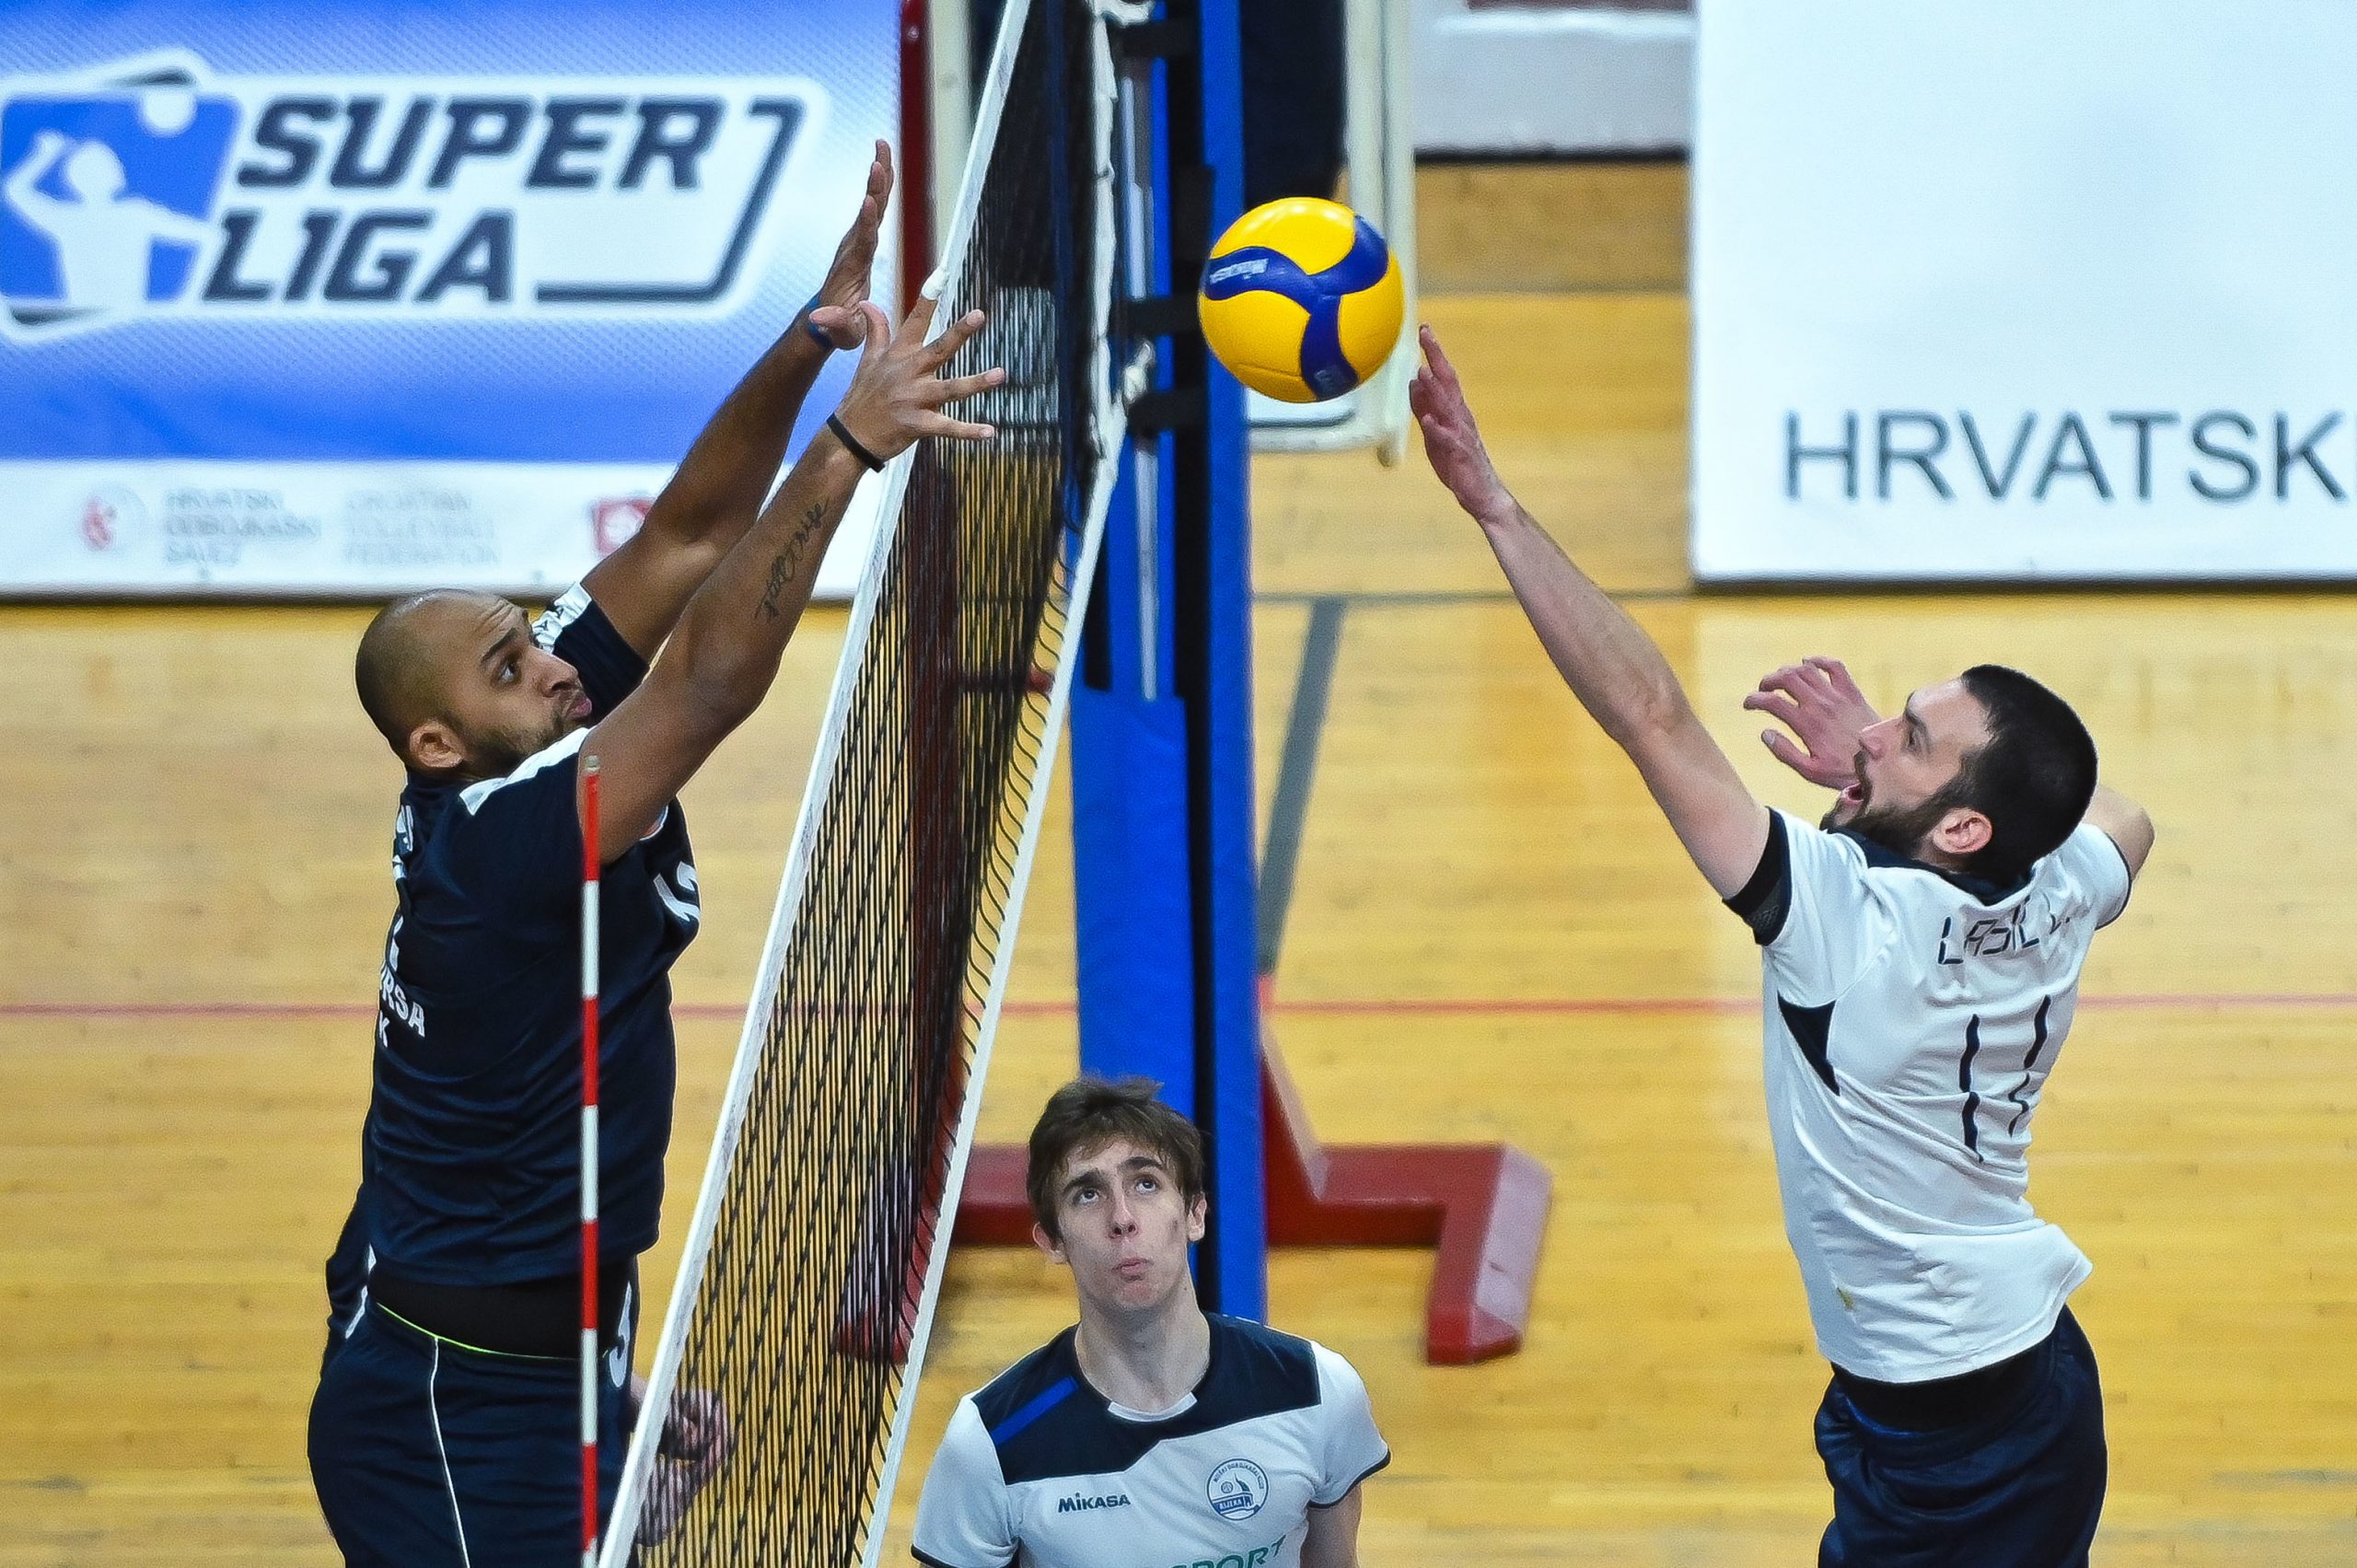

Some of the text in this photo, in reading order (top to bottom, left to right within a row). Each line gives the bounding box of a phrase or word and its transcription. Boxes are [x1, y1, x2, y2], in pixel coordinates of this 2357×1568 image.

[238, 99, 723, 190] SUPER
[203, 213, 515, 302] LIGA
[1171, 1534, 1286, 1568] ORT
